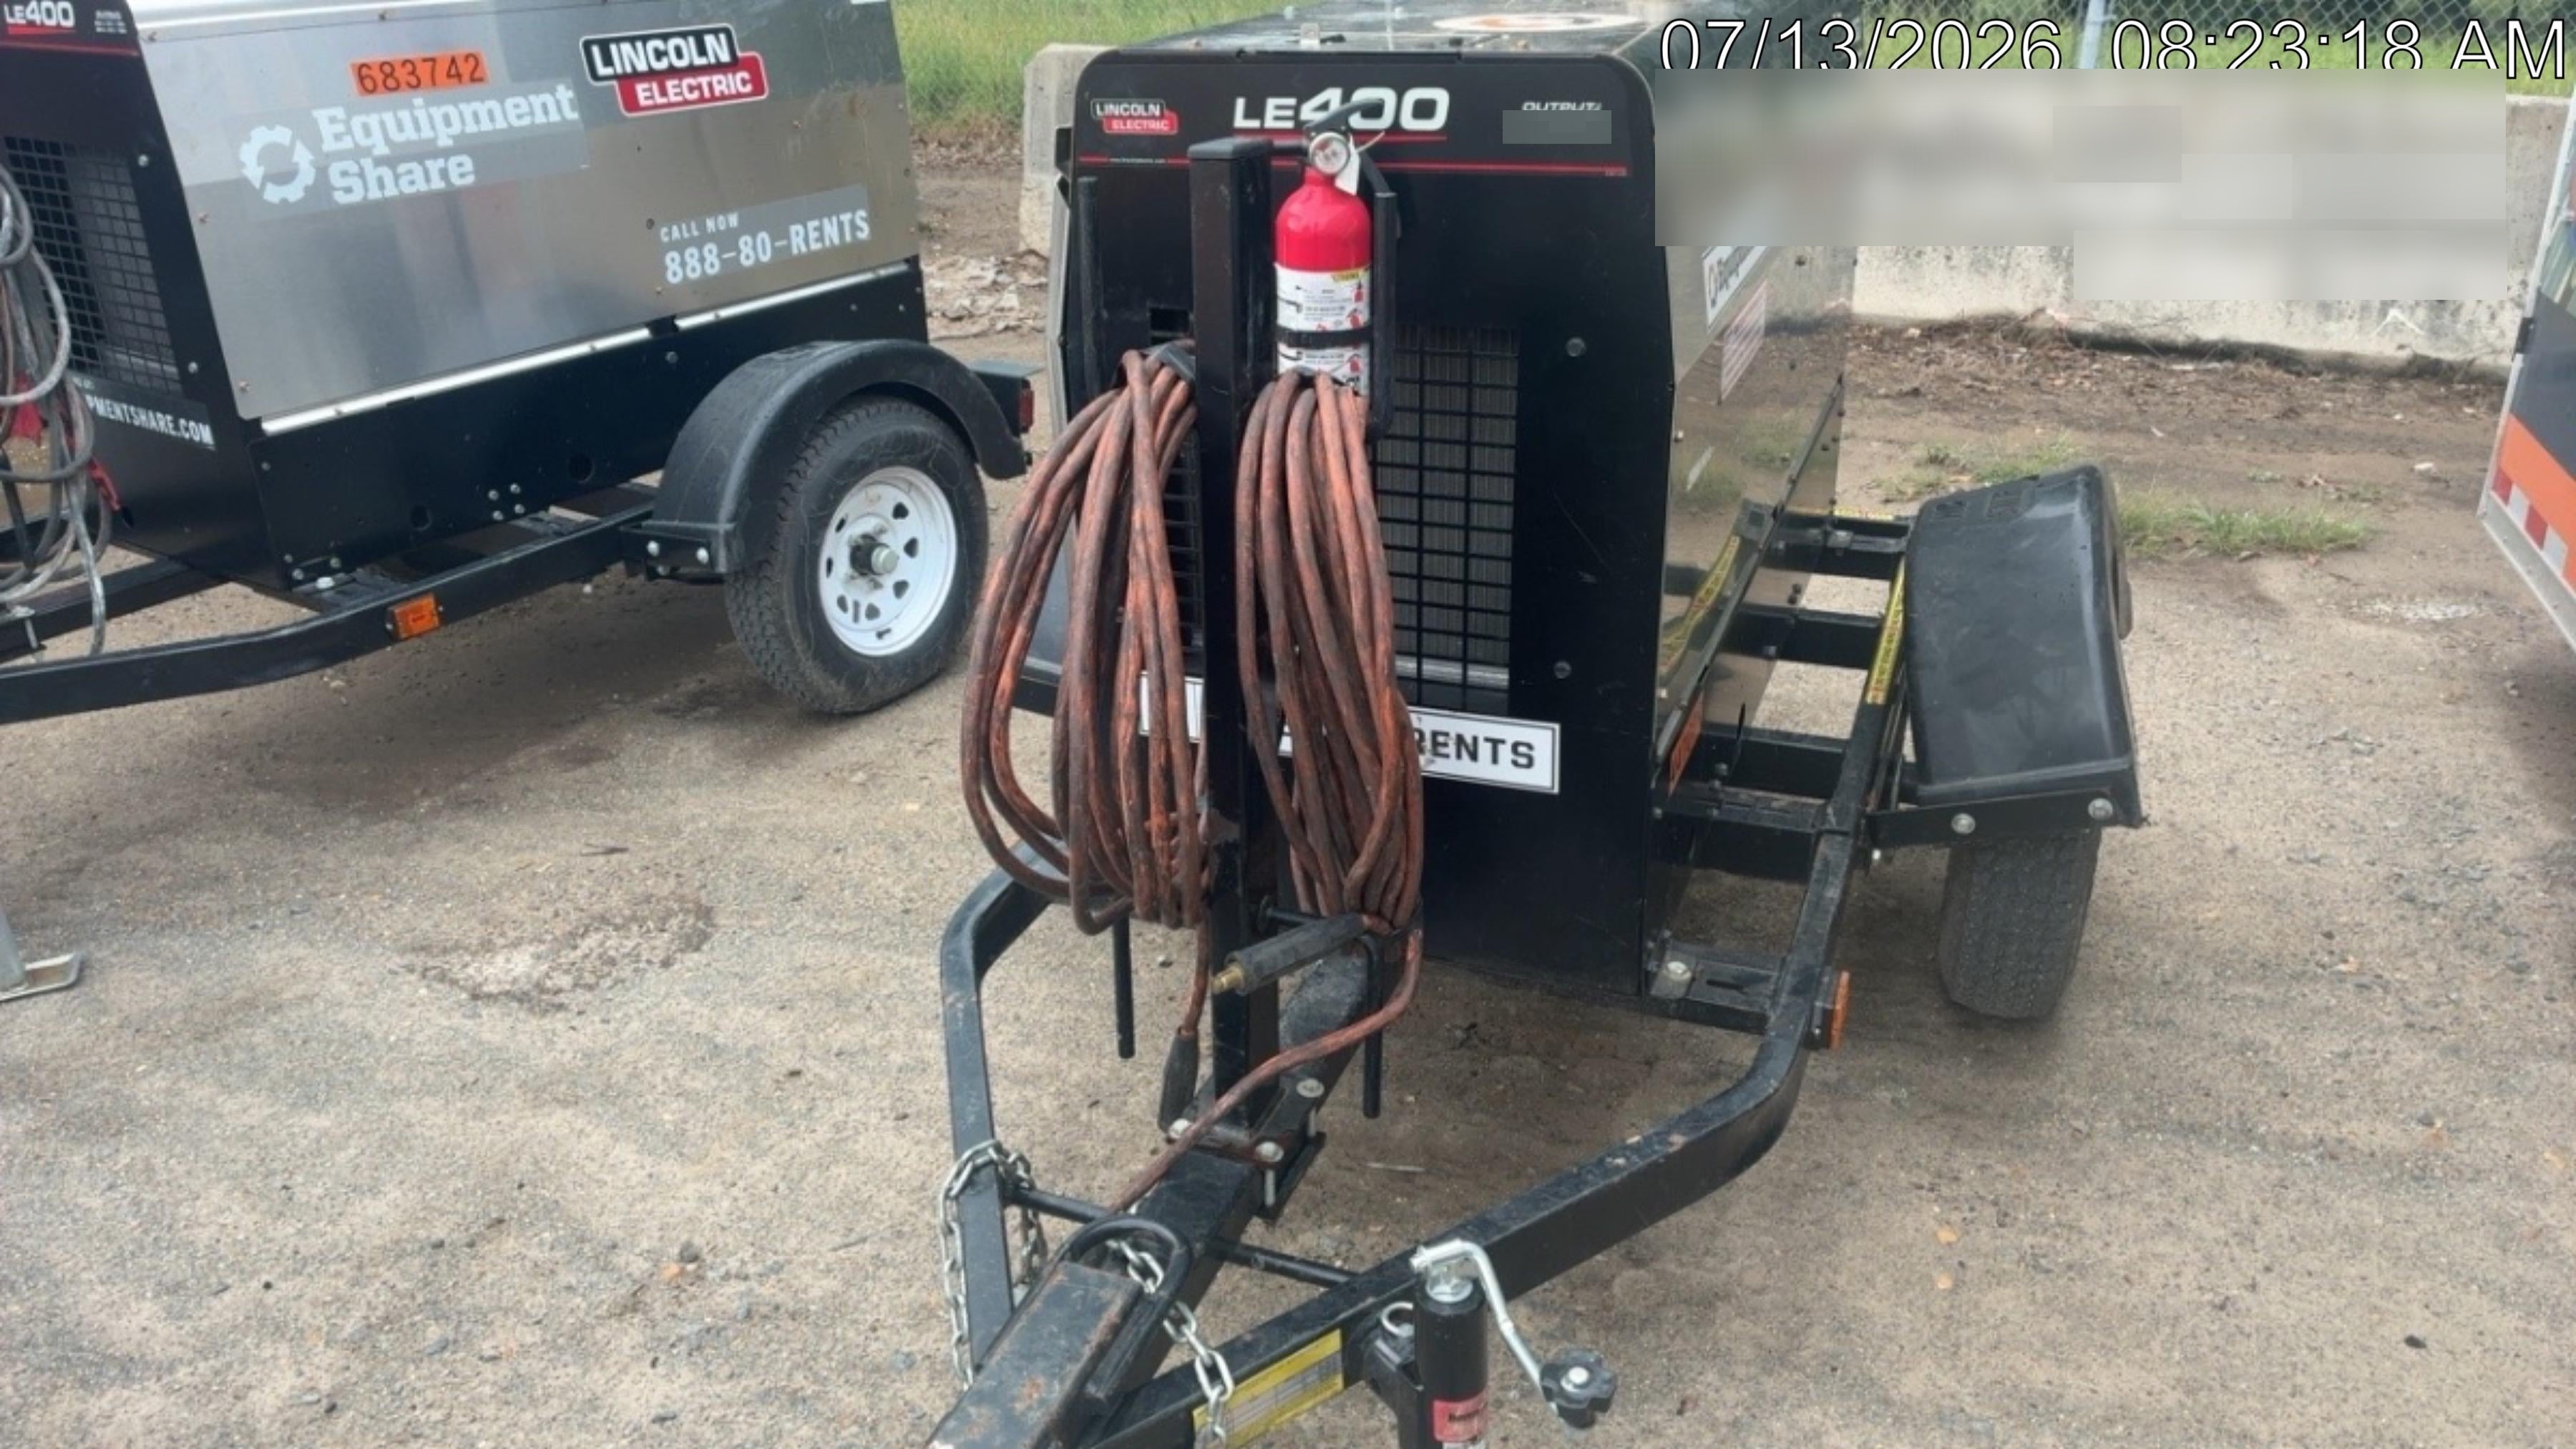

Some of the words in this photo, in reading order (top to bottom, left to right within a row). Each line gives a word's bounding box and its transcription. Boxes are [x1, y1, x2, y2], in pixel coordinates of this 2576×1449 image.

[4, 1, 75, 27] LE400
[358, 52, 485, 94] 683742
[592, 33, 731, 77] LINCOLN
[635, 71, 753, 107] ELECTRIC
[1096, 103, 1161, 117] LINCOLN
[1233, 87, 1450, 131] LE400
[312, 84, 579, 155] Equipment
[1111, 119, 1169, 131] ELECTRIC
[327, 153, 475, 205] Share
[660, 220, 700, 243] CALL
[706, 213, 738, 235] NOW
[665, 210, 870, 284] 888-80-RENTS
